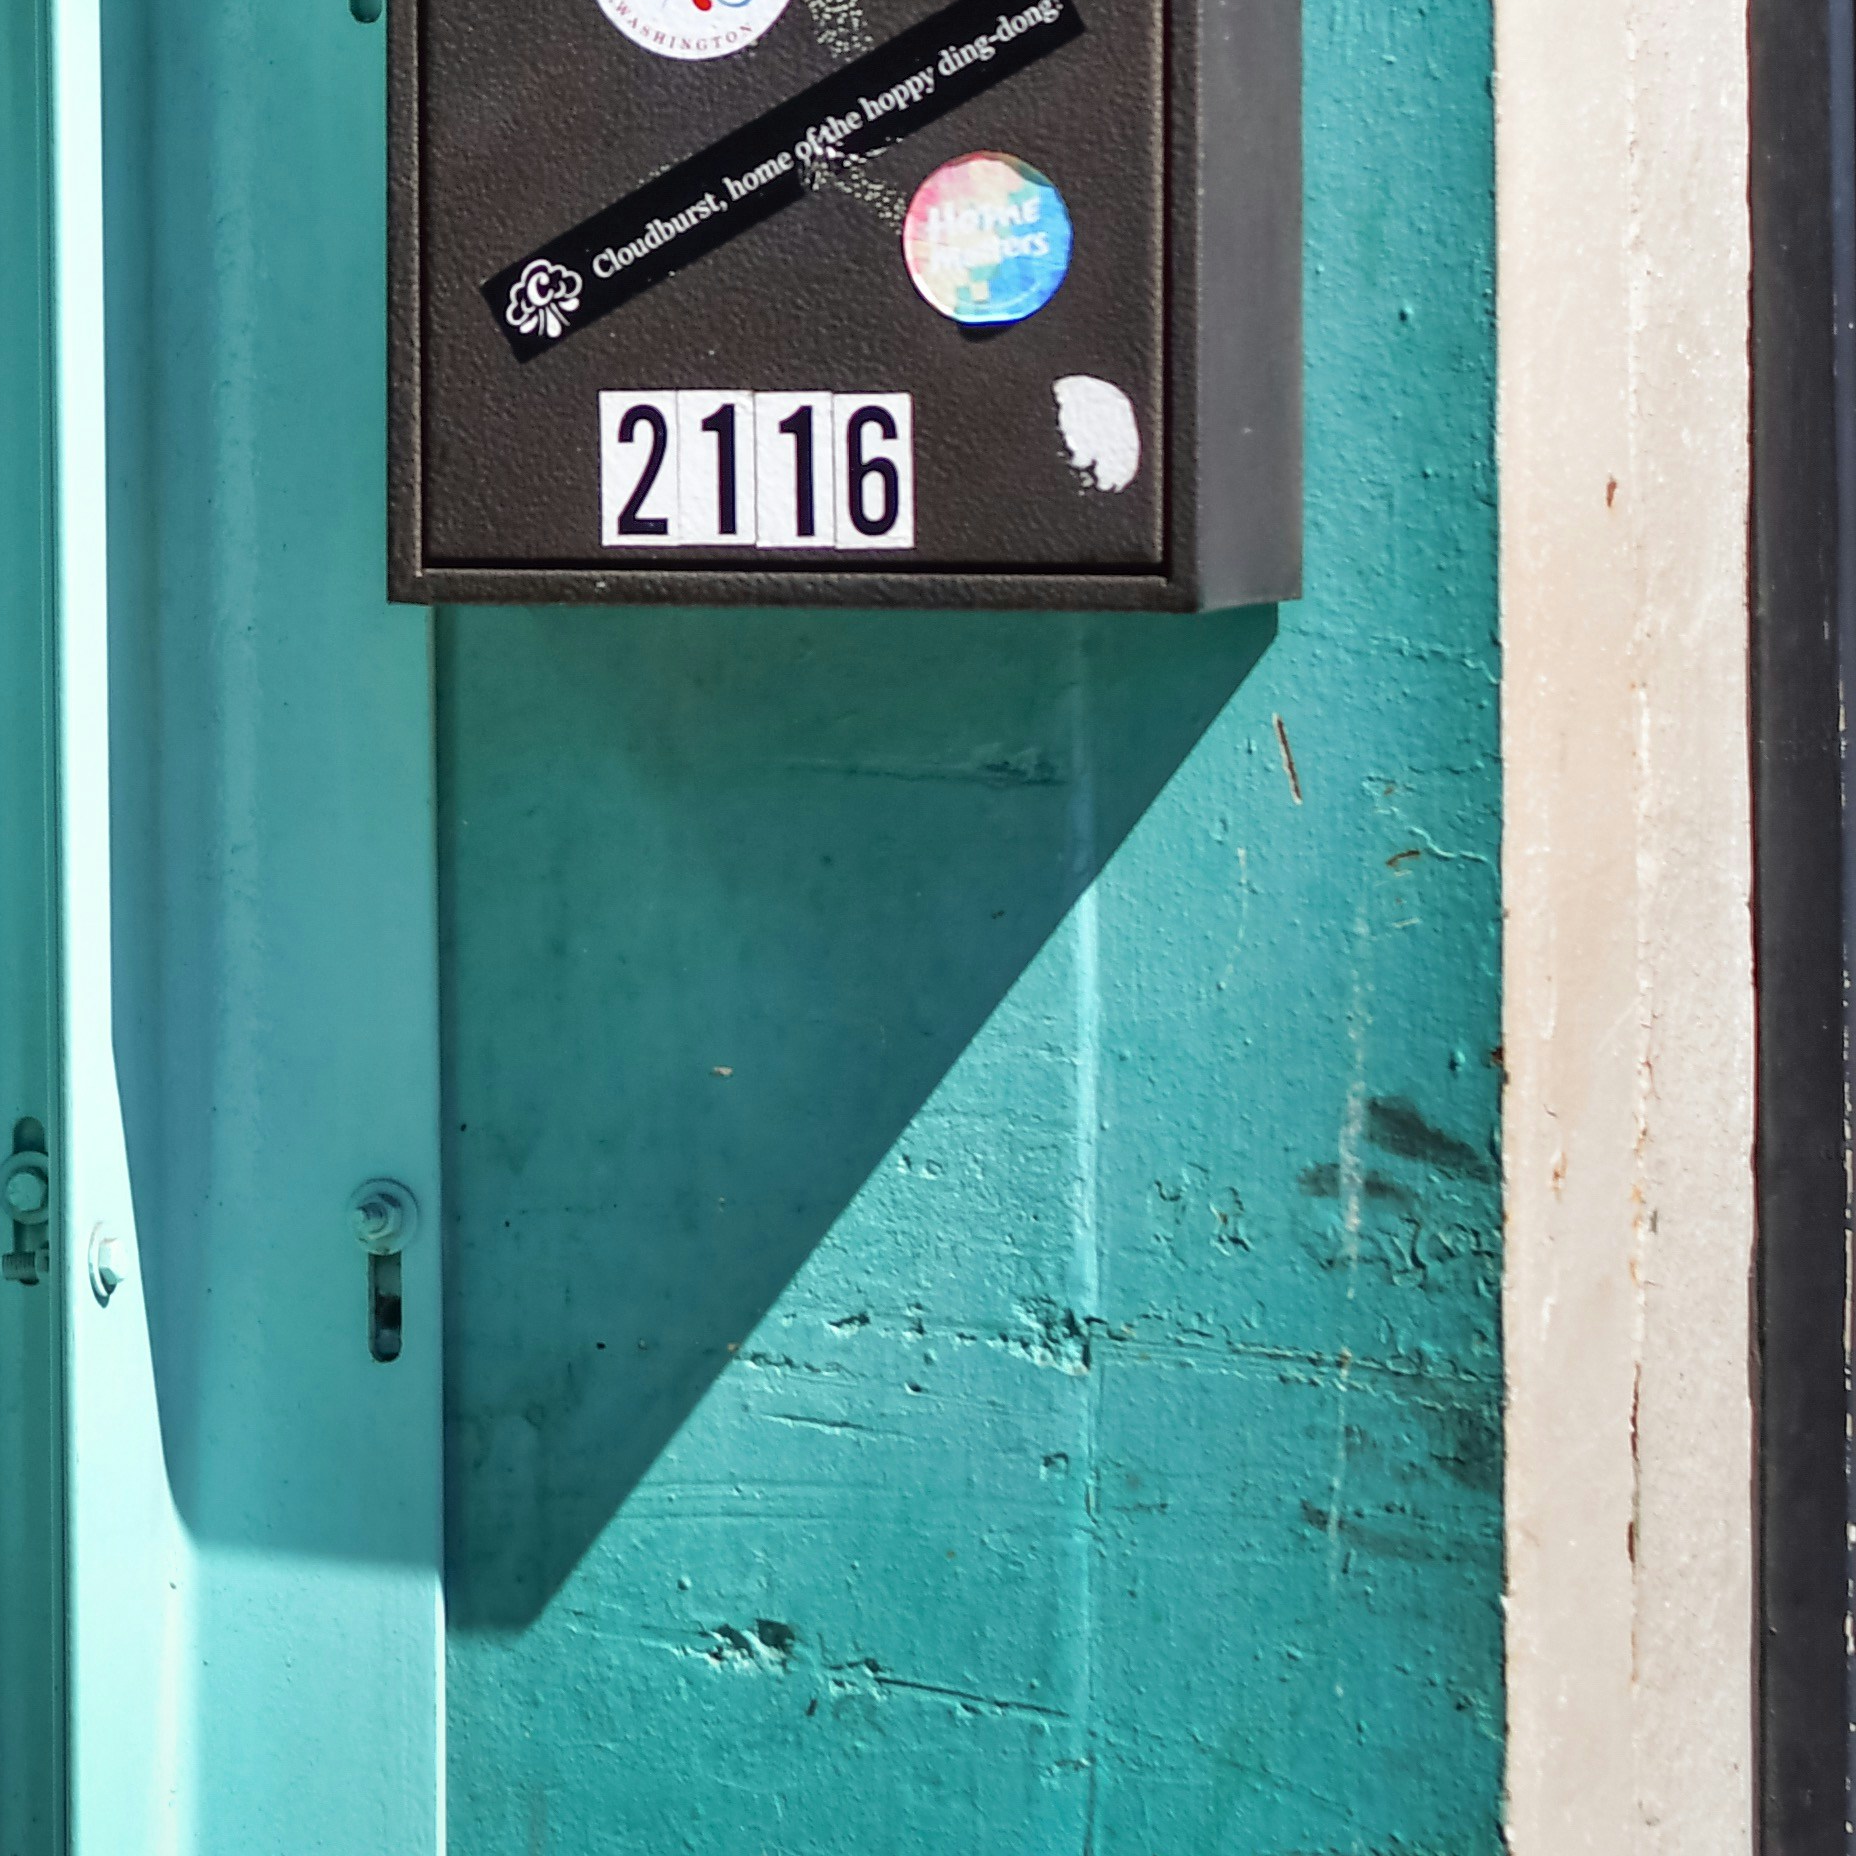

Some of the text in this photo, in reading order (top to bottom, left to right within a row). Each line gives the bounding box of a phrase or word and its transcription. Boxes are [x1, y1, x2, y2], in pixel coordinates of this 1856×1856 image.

[615, 0, 753, 52] WASHINGTON
[591, 192, 729, 278] Cloudburst,
[721, 150, 795, 202] home
[794, 126, 823, 162] of
[818, 115, 865, 146] the
[857, 65, 935, 121] hoppy
[617, 403, 900, 538] 2116
